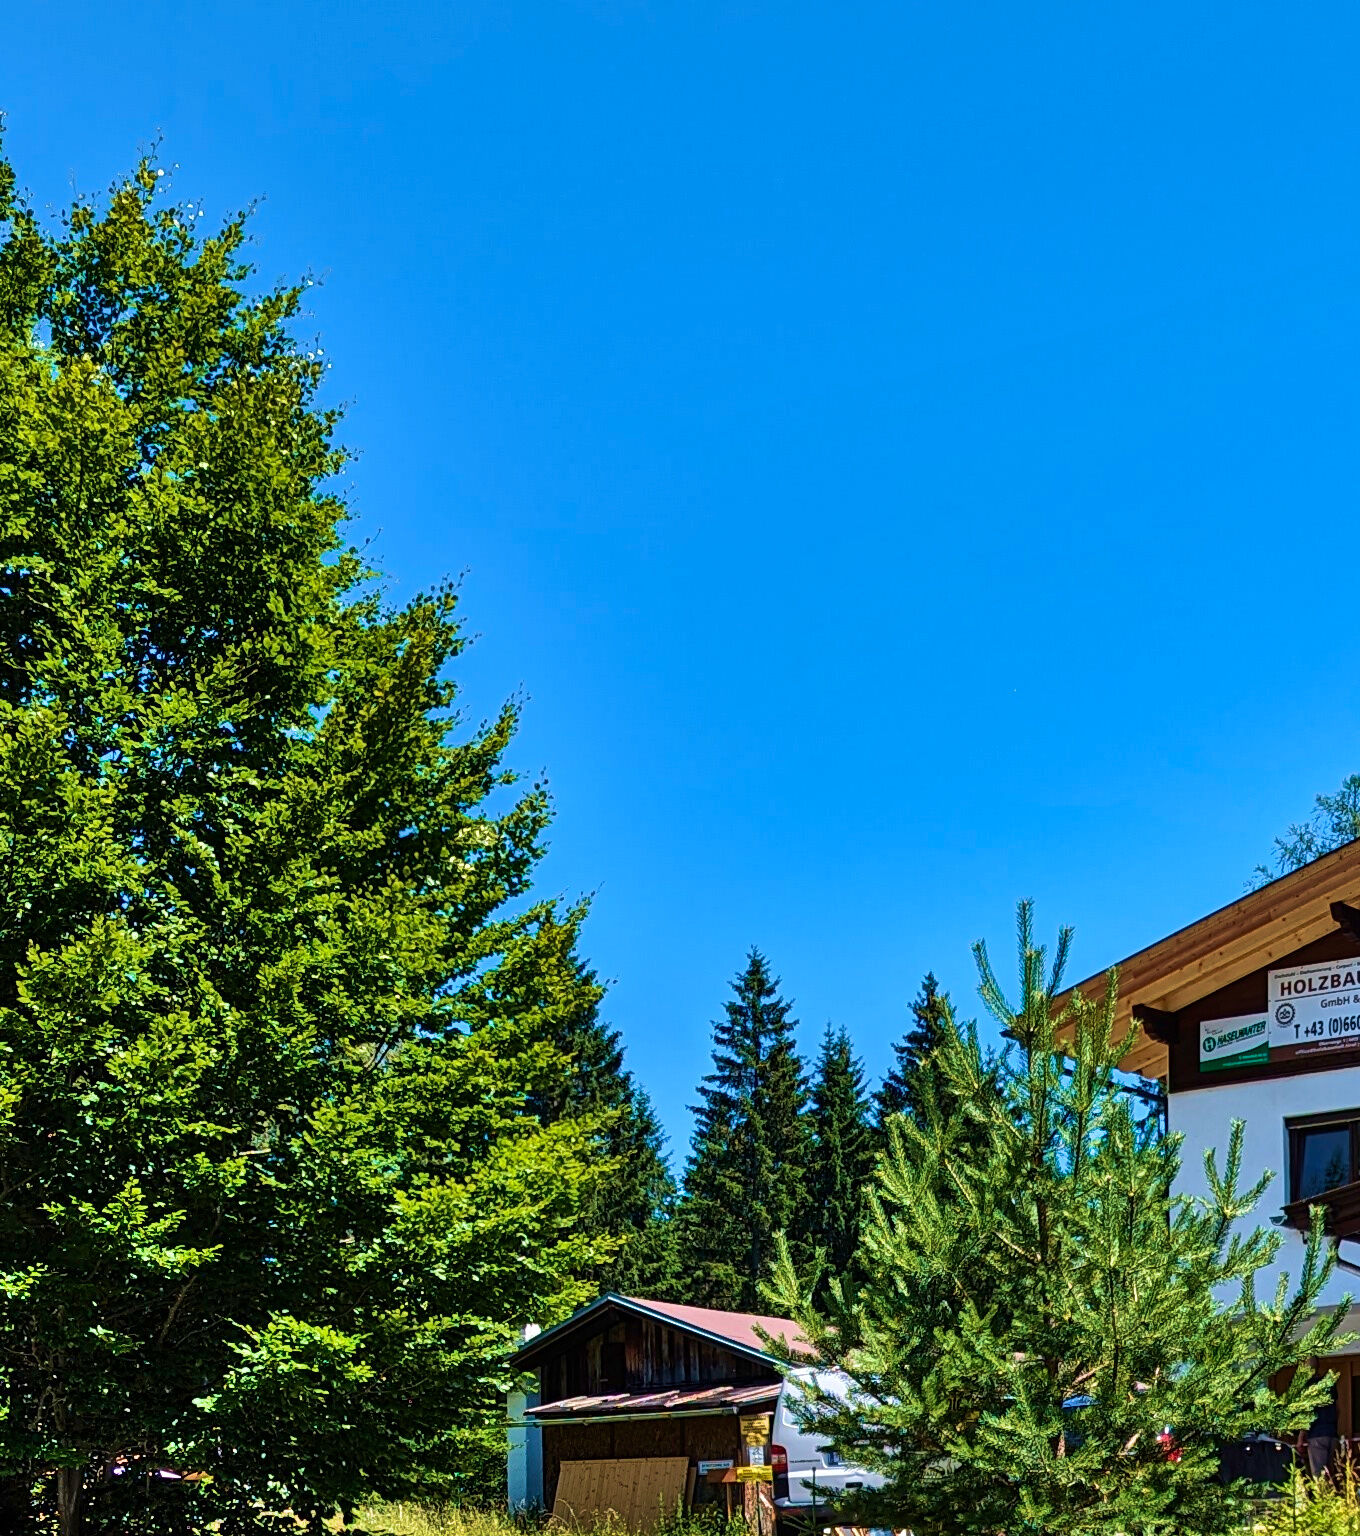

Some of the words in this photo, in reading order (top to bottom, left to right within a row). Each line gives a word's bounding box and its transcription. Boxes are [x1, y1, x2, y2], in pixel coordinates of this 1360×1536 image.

[1320, 995, 1351, 1009] GmbH
[1353, 994, 1360, 1004] &
[1294, 1023, 1301, 1039] T
[1304, 1020, 1324, 1038] +43
